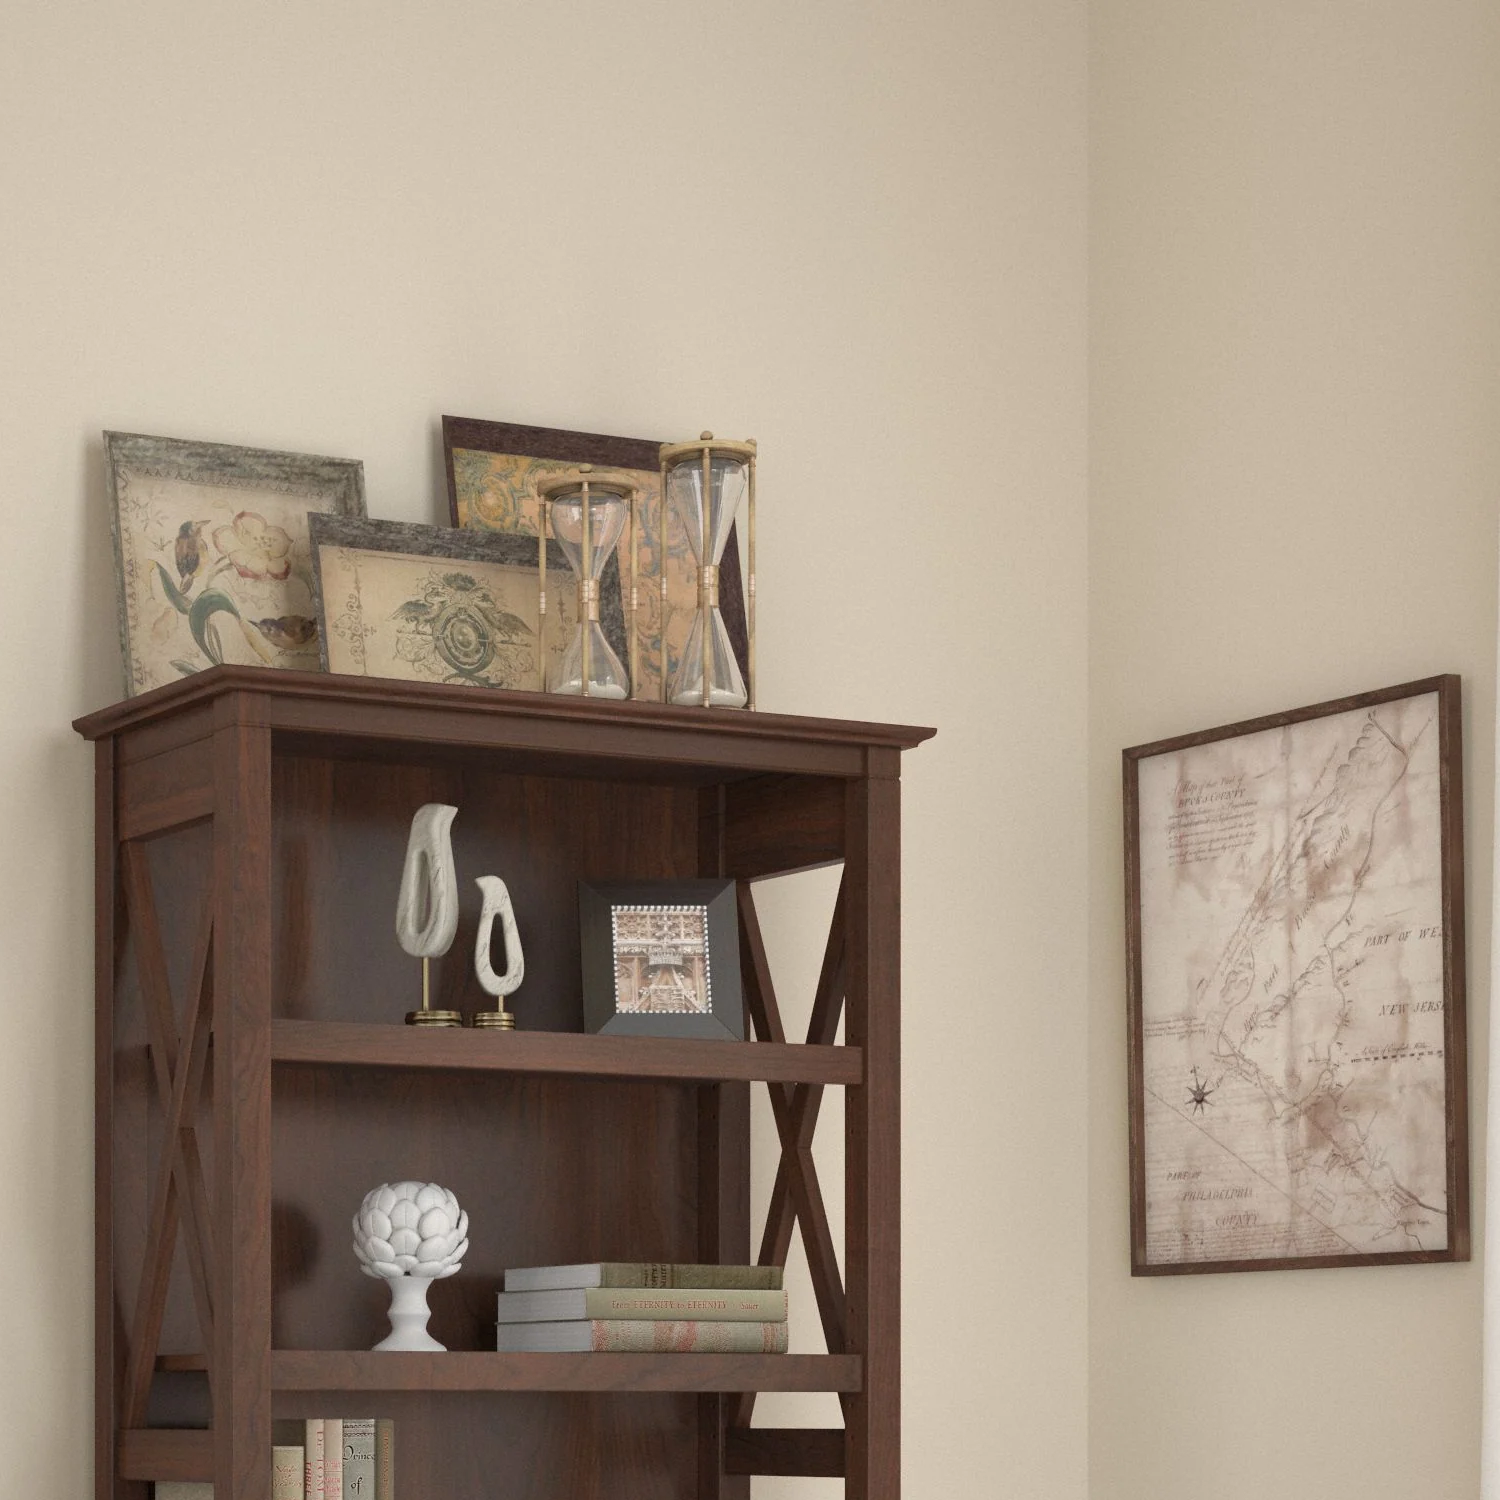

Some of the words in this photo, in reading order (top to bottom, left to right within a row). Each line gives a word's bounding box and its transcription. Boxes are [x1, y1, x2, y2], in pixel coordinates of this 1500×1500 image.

[1364, 934, 1390, 947] PART
[1398, 930, 1412, 942] OF
[1419, 926, 1443, 939] WE
[1379, 1003, 1409, 1016] NEW
[633, 1300, 674, 1309] ETERNITY
[676, 1301, 685, 1309] to
[687, 1300, 727, 1310] ETERNITY
[350, 1476, 363, 1495] of
